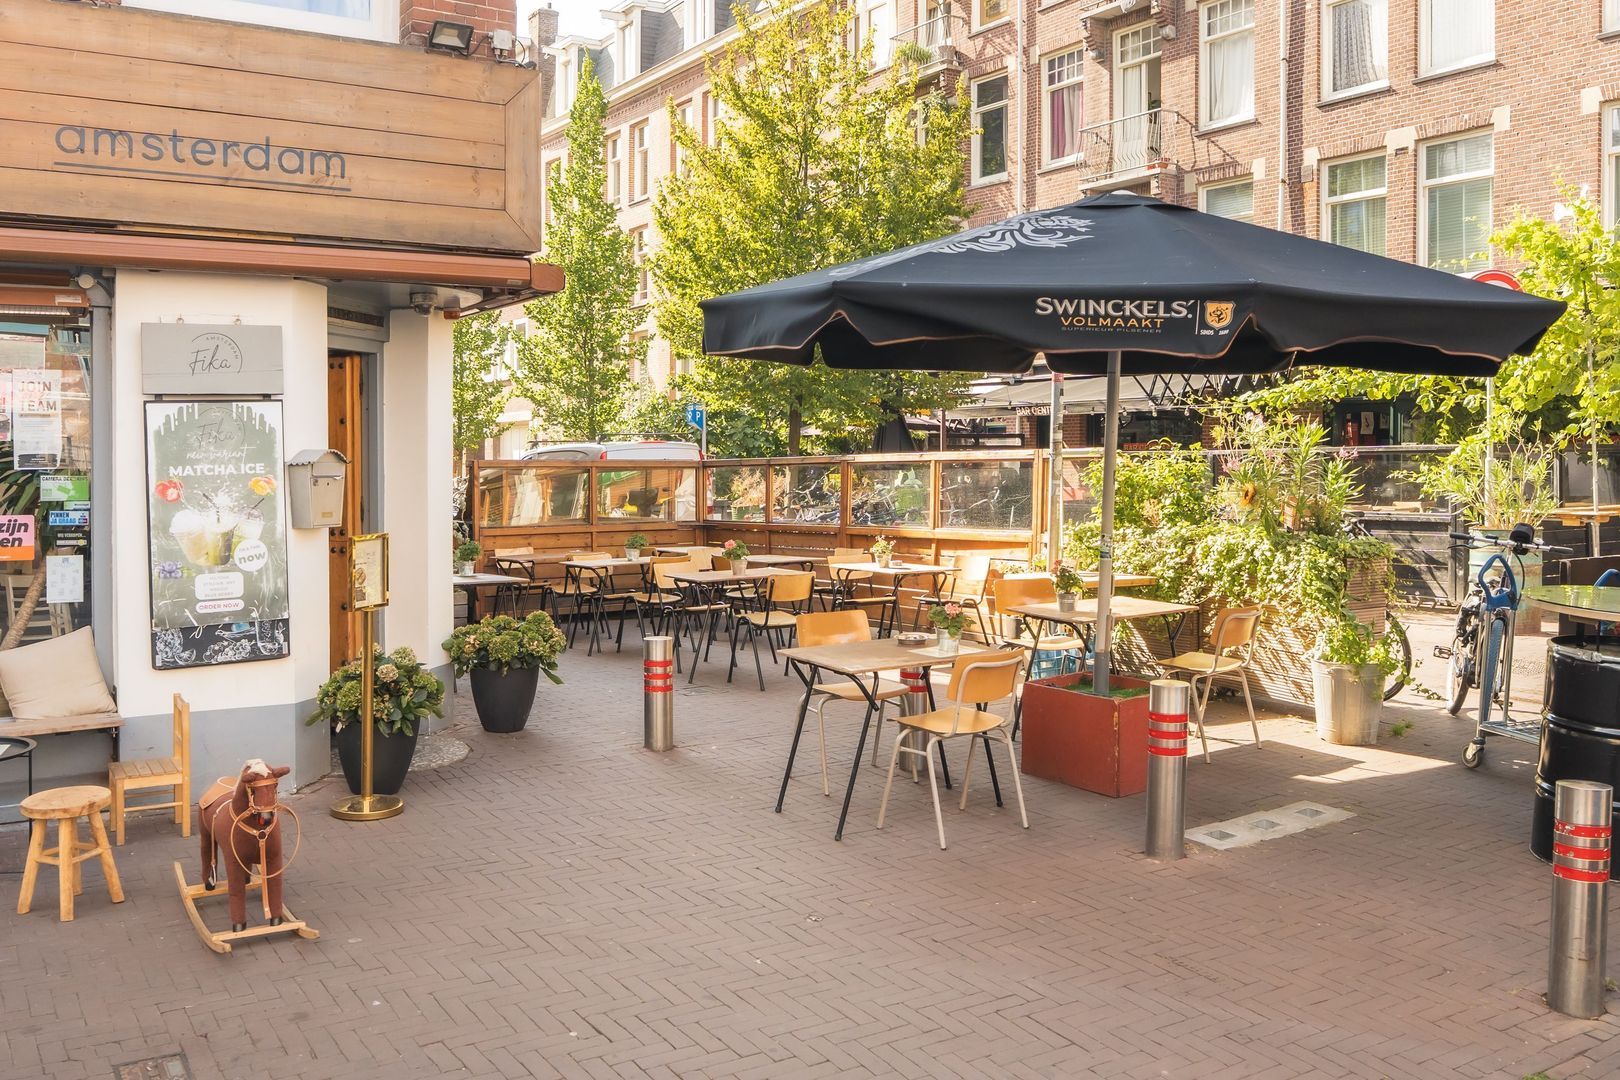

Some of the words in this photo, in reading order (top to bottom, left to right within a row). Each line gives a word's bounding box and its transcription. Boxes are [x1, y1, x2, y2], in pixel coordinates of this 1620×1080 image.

[55, 124, 346, 179] amsterdam
[1060, 316, 1165, 328] VOLMAAKT
[206, 335, 240, 360] AMSTERDAM
[189, 344, 231, 376] Fika
[19, 381, 52, 392] JOIN
[20, 400, 57, 412] TEAM
[1016, 407, 1031, 416] BAR
[168, 464, 237, 477] MATCHA
[240, 463, 265, 474] ICE
[239, 552, 266, 565] now
